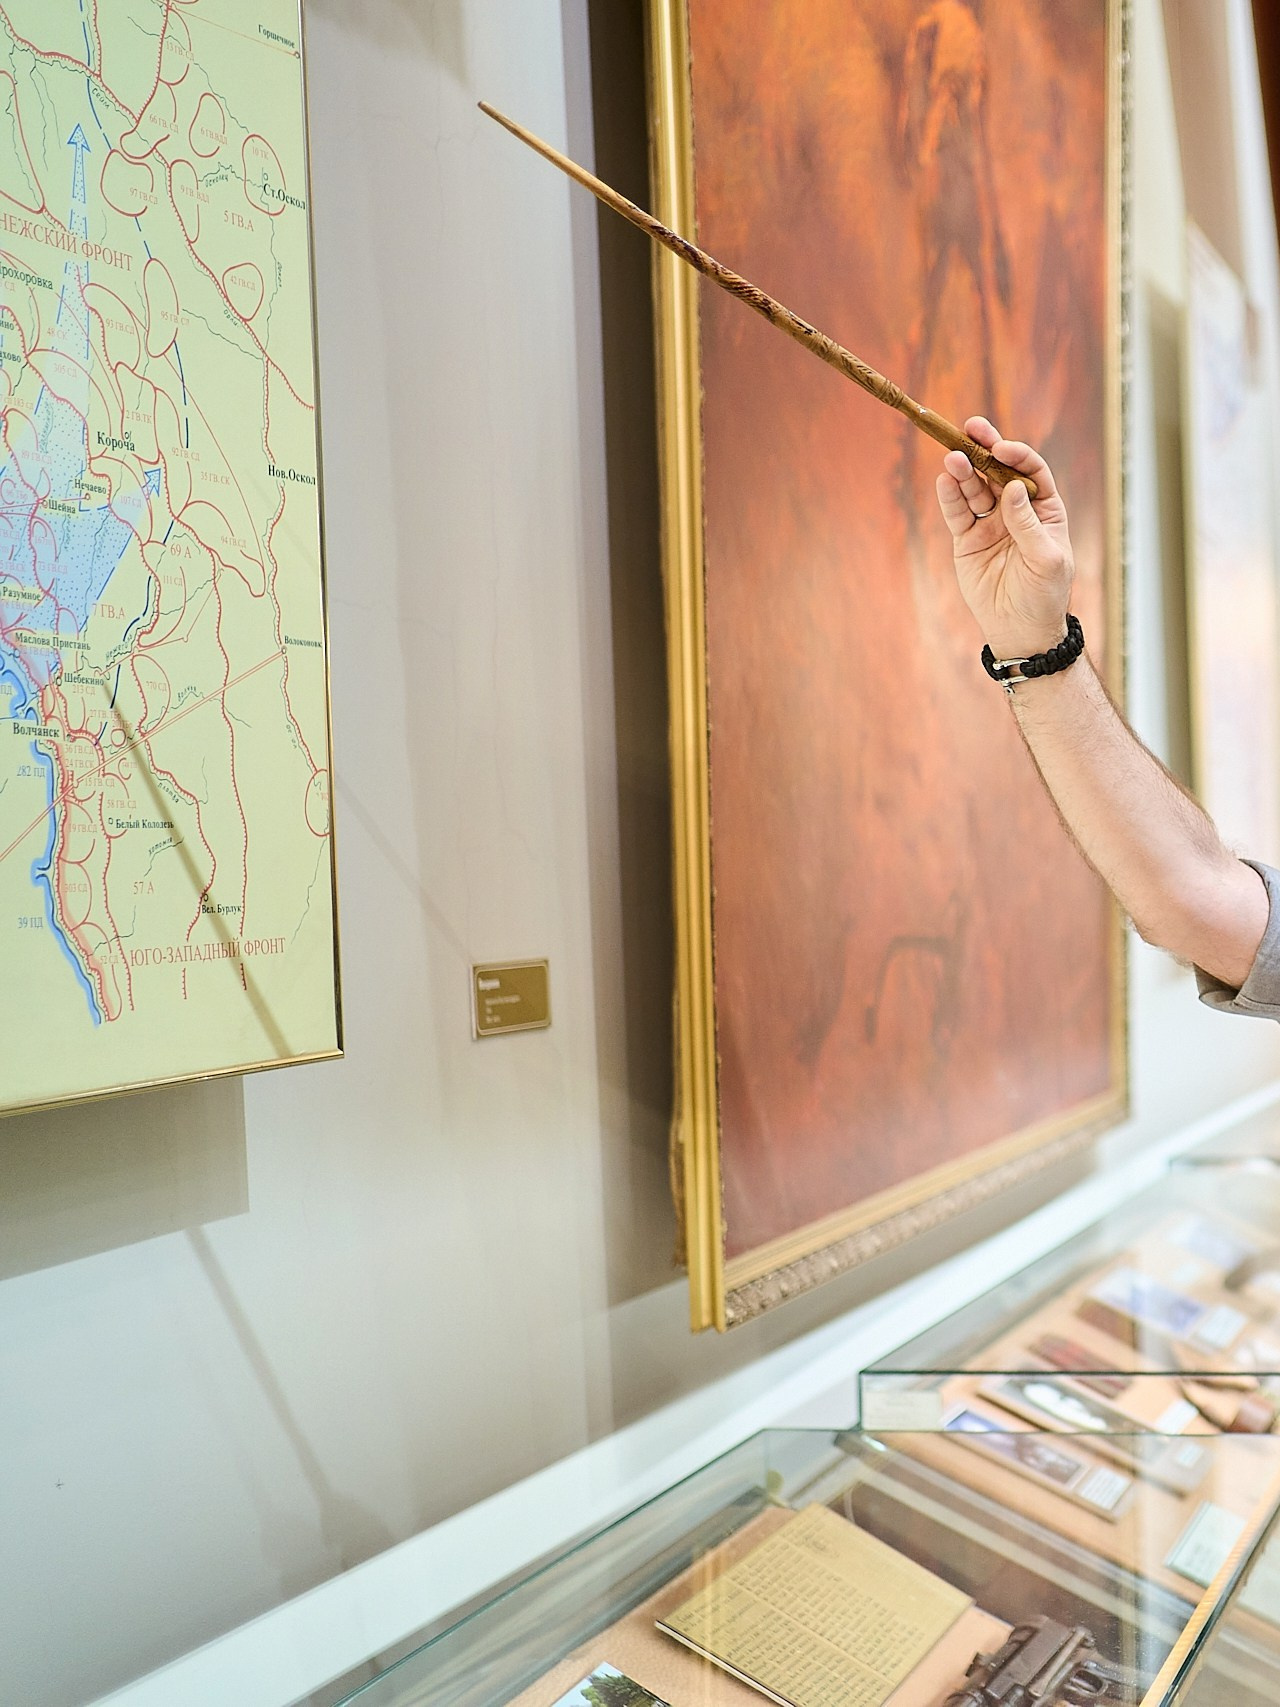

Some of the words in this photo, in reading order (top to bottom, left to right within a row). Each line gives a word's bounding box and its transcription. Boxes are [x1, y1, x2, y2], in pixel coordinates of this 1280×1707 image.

[224, 210, 228, 222] 5
[81, 240, 134, 272] ФРОНТ
[96, 431, 135, 452] Короча
[74, 479, 107, 494] Нечаево
[48, 500, 76, 514] Шейна
[170, 543, 182, 557] 69
[184, 546, 192, 559] А
[2, 586, 41, 601] Разумное
[92, 603, 97, 616] 7
[15, 632, 50, 646] Маслова
[52, 637, 91, 650] Пристань
[64, 672, 104, 686] Шебекино
[13, 720, 60, 737] Волчанск
[34, 767, 45, 777] ПД
[116, 819, 140, 829] Белый
[141, 819, 175, 829] Колодезь
[133, 881, 144, 895] 57
[147, 881, 154, 895] А
[217, 904, 241, 916] Бурлук
[18, 917, 28, 928] 39
[30, 917, 43, 928] ПД
[130, 936, 240, 967] ЮГО-ЗАПАДНЫЙ
[244, 937, 286, 956] ФРОНТ
